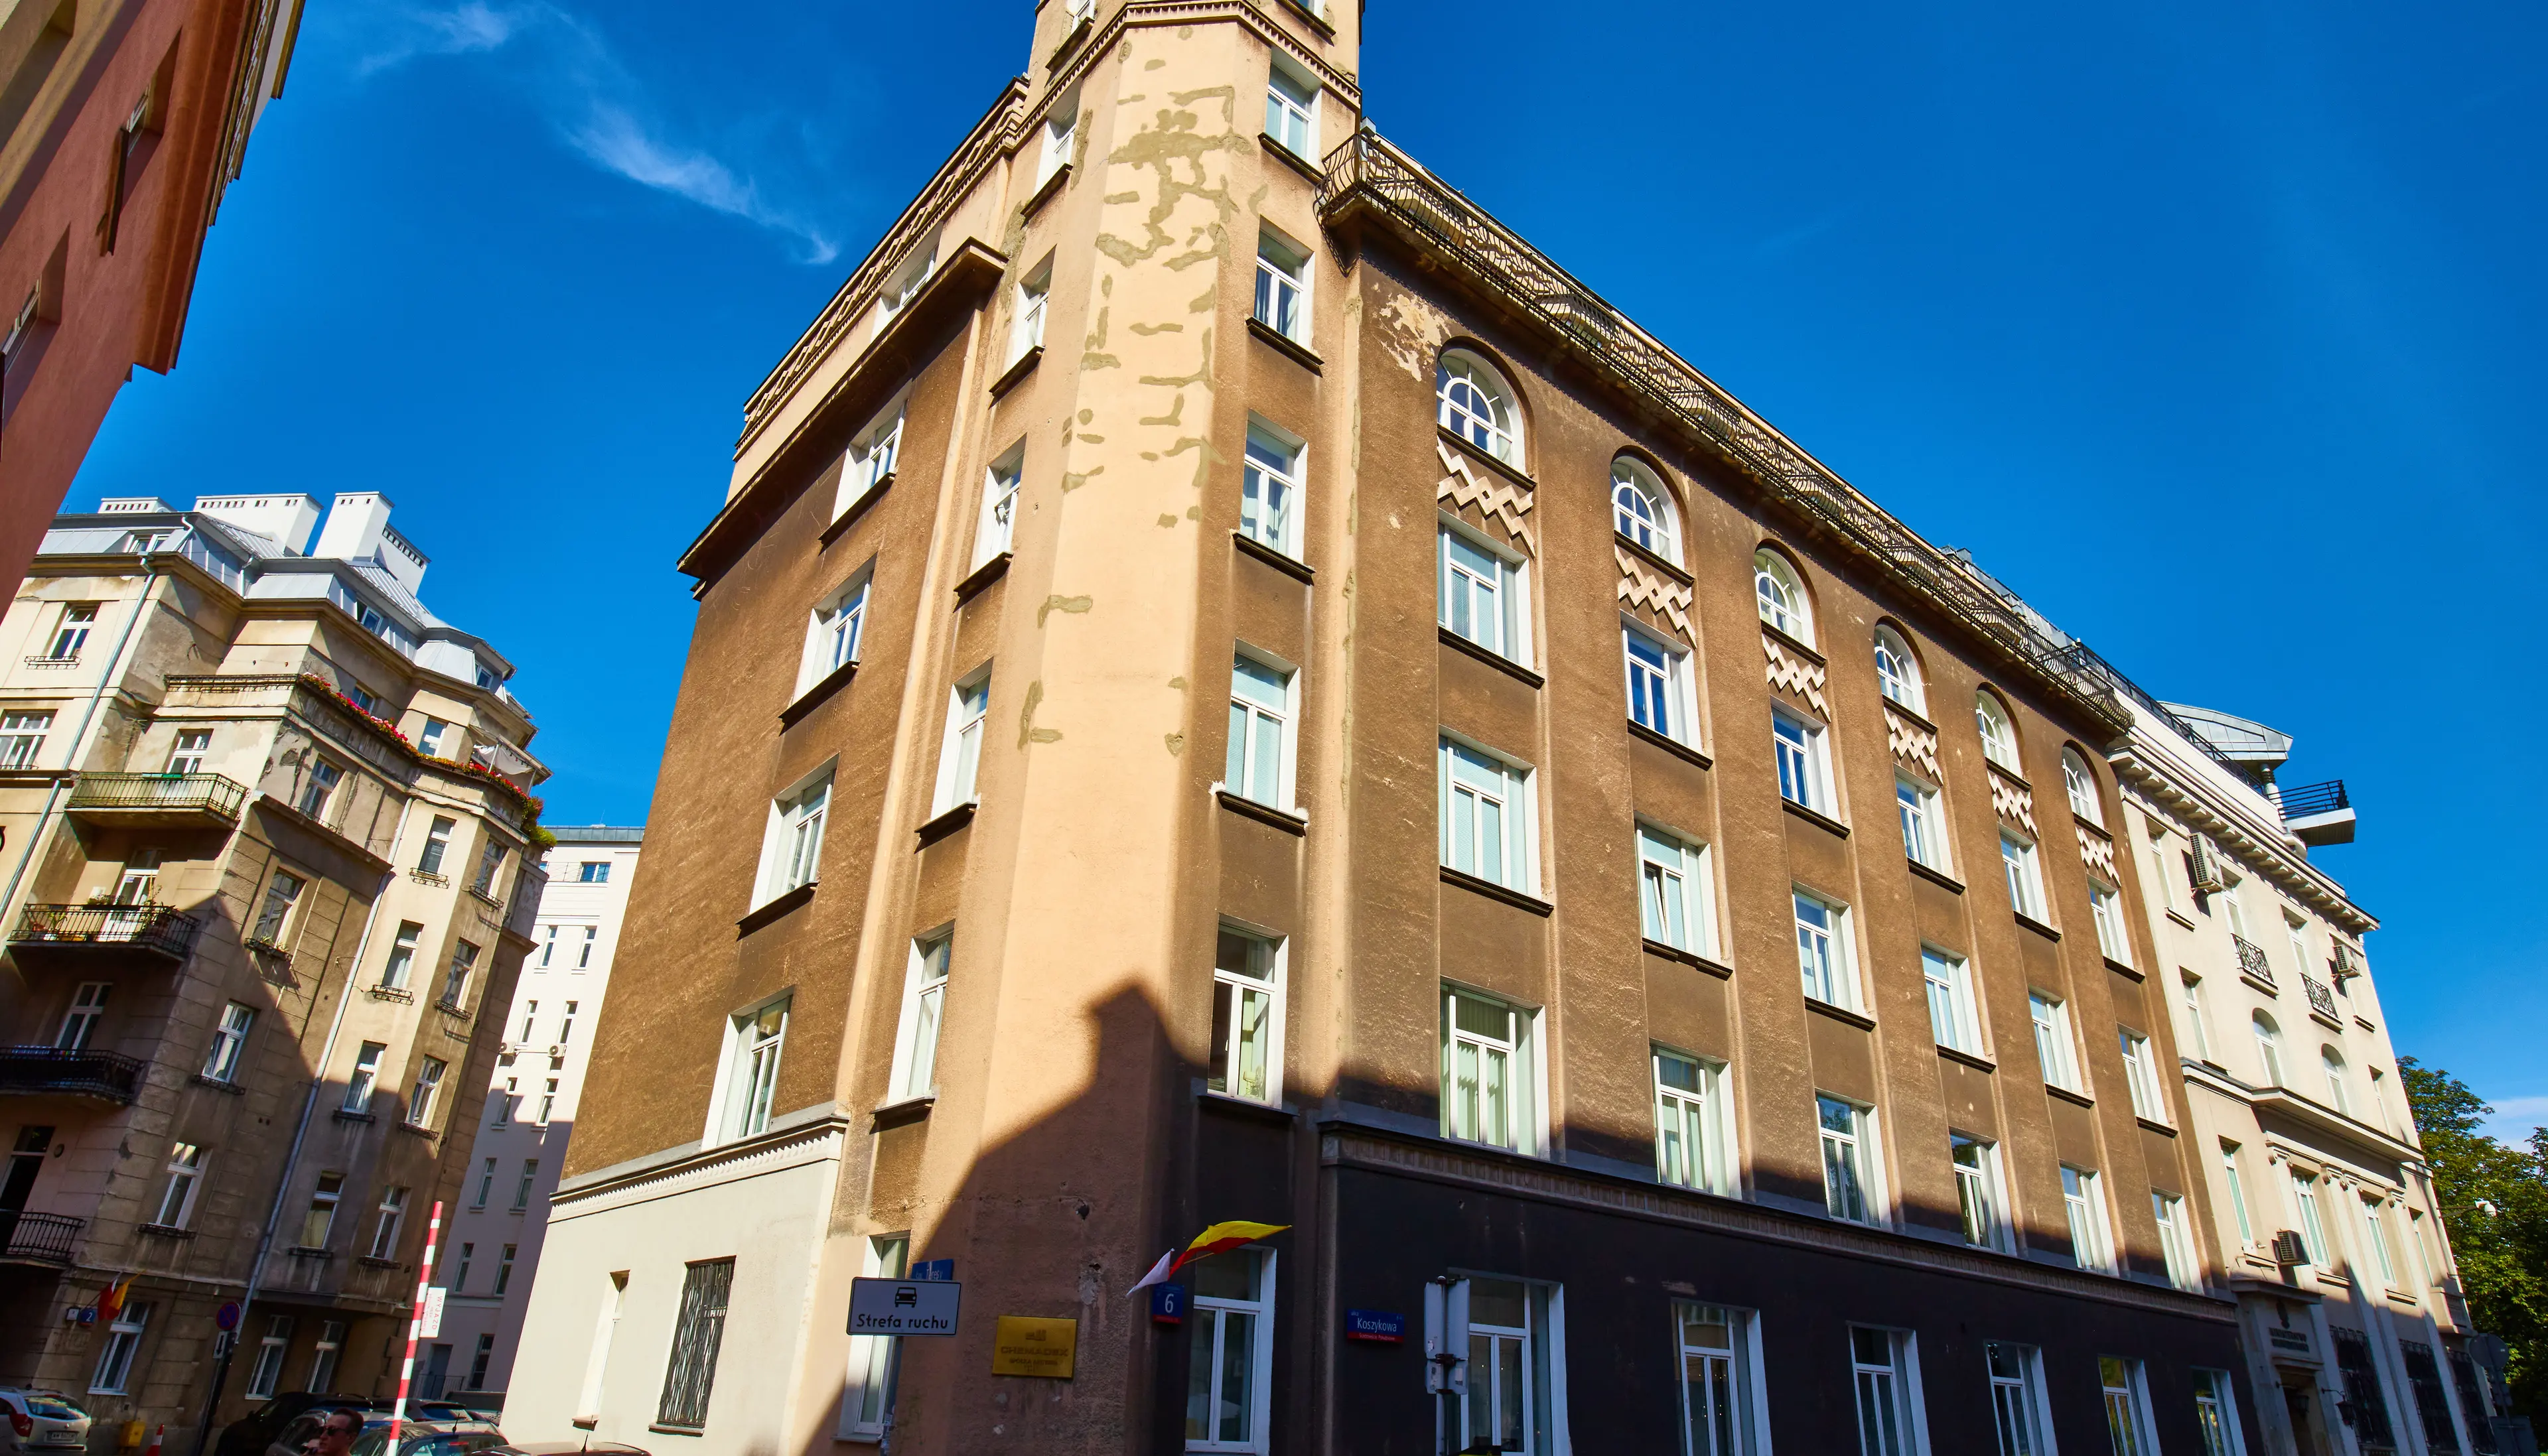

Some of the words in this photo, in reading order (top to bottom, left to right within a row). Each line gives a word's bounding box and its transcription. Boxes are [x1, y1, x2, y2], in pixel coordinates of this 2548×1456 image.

[1165, 1293, 1174, 1314] 6
[86, 1311, 93, 1322] 2
[432, 1295, 444, 1330] WYJAZD
[857, 1313, 901, 1328] Strefa
[908, 1315, 948, 1329] ruchu
[1357, 1317, 1397, 1333] Koszykowa
[1001, 1346, 1069, 1357] CHEMADEX
